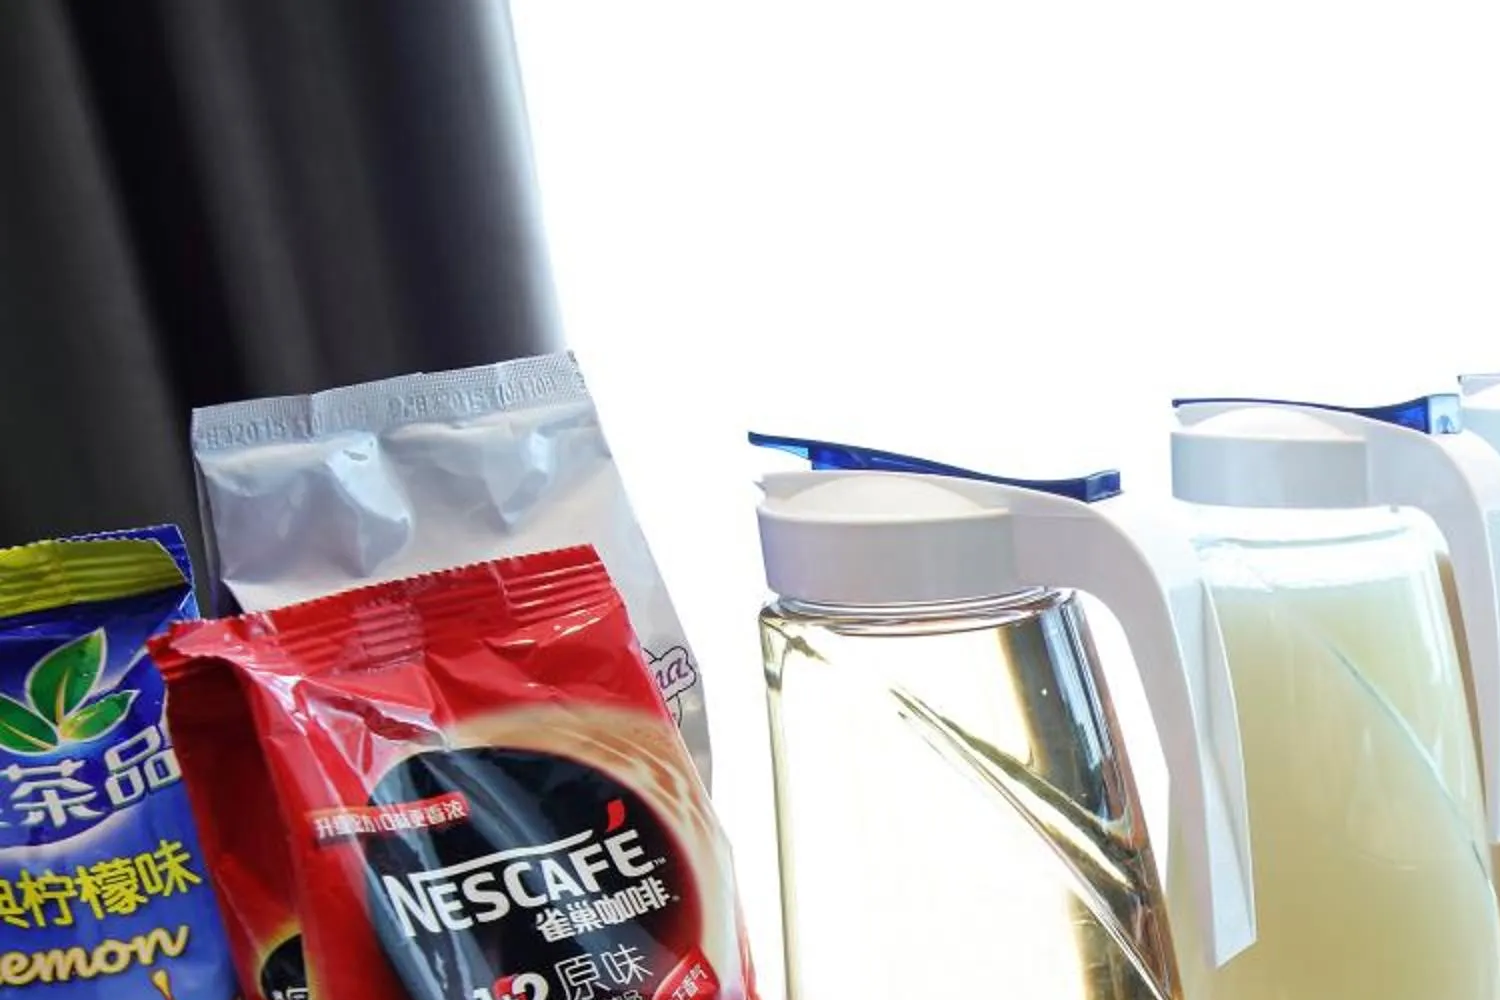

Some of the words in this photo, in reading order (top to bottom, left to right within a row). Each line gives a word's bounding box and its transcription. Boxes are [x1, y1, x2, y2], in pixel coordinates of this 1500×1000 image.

[0, 725, 182, 828] 茶品
[534, 877, 671, 943] 雀巢咖啡
[0, 924, 190, 986] emon
